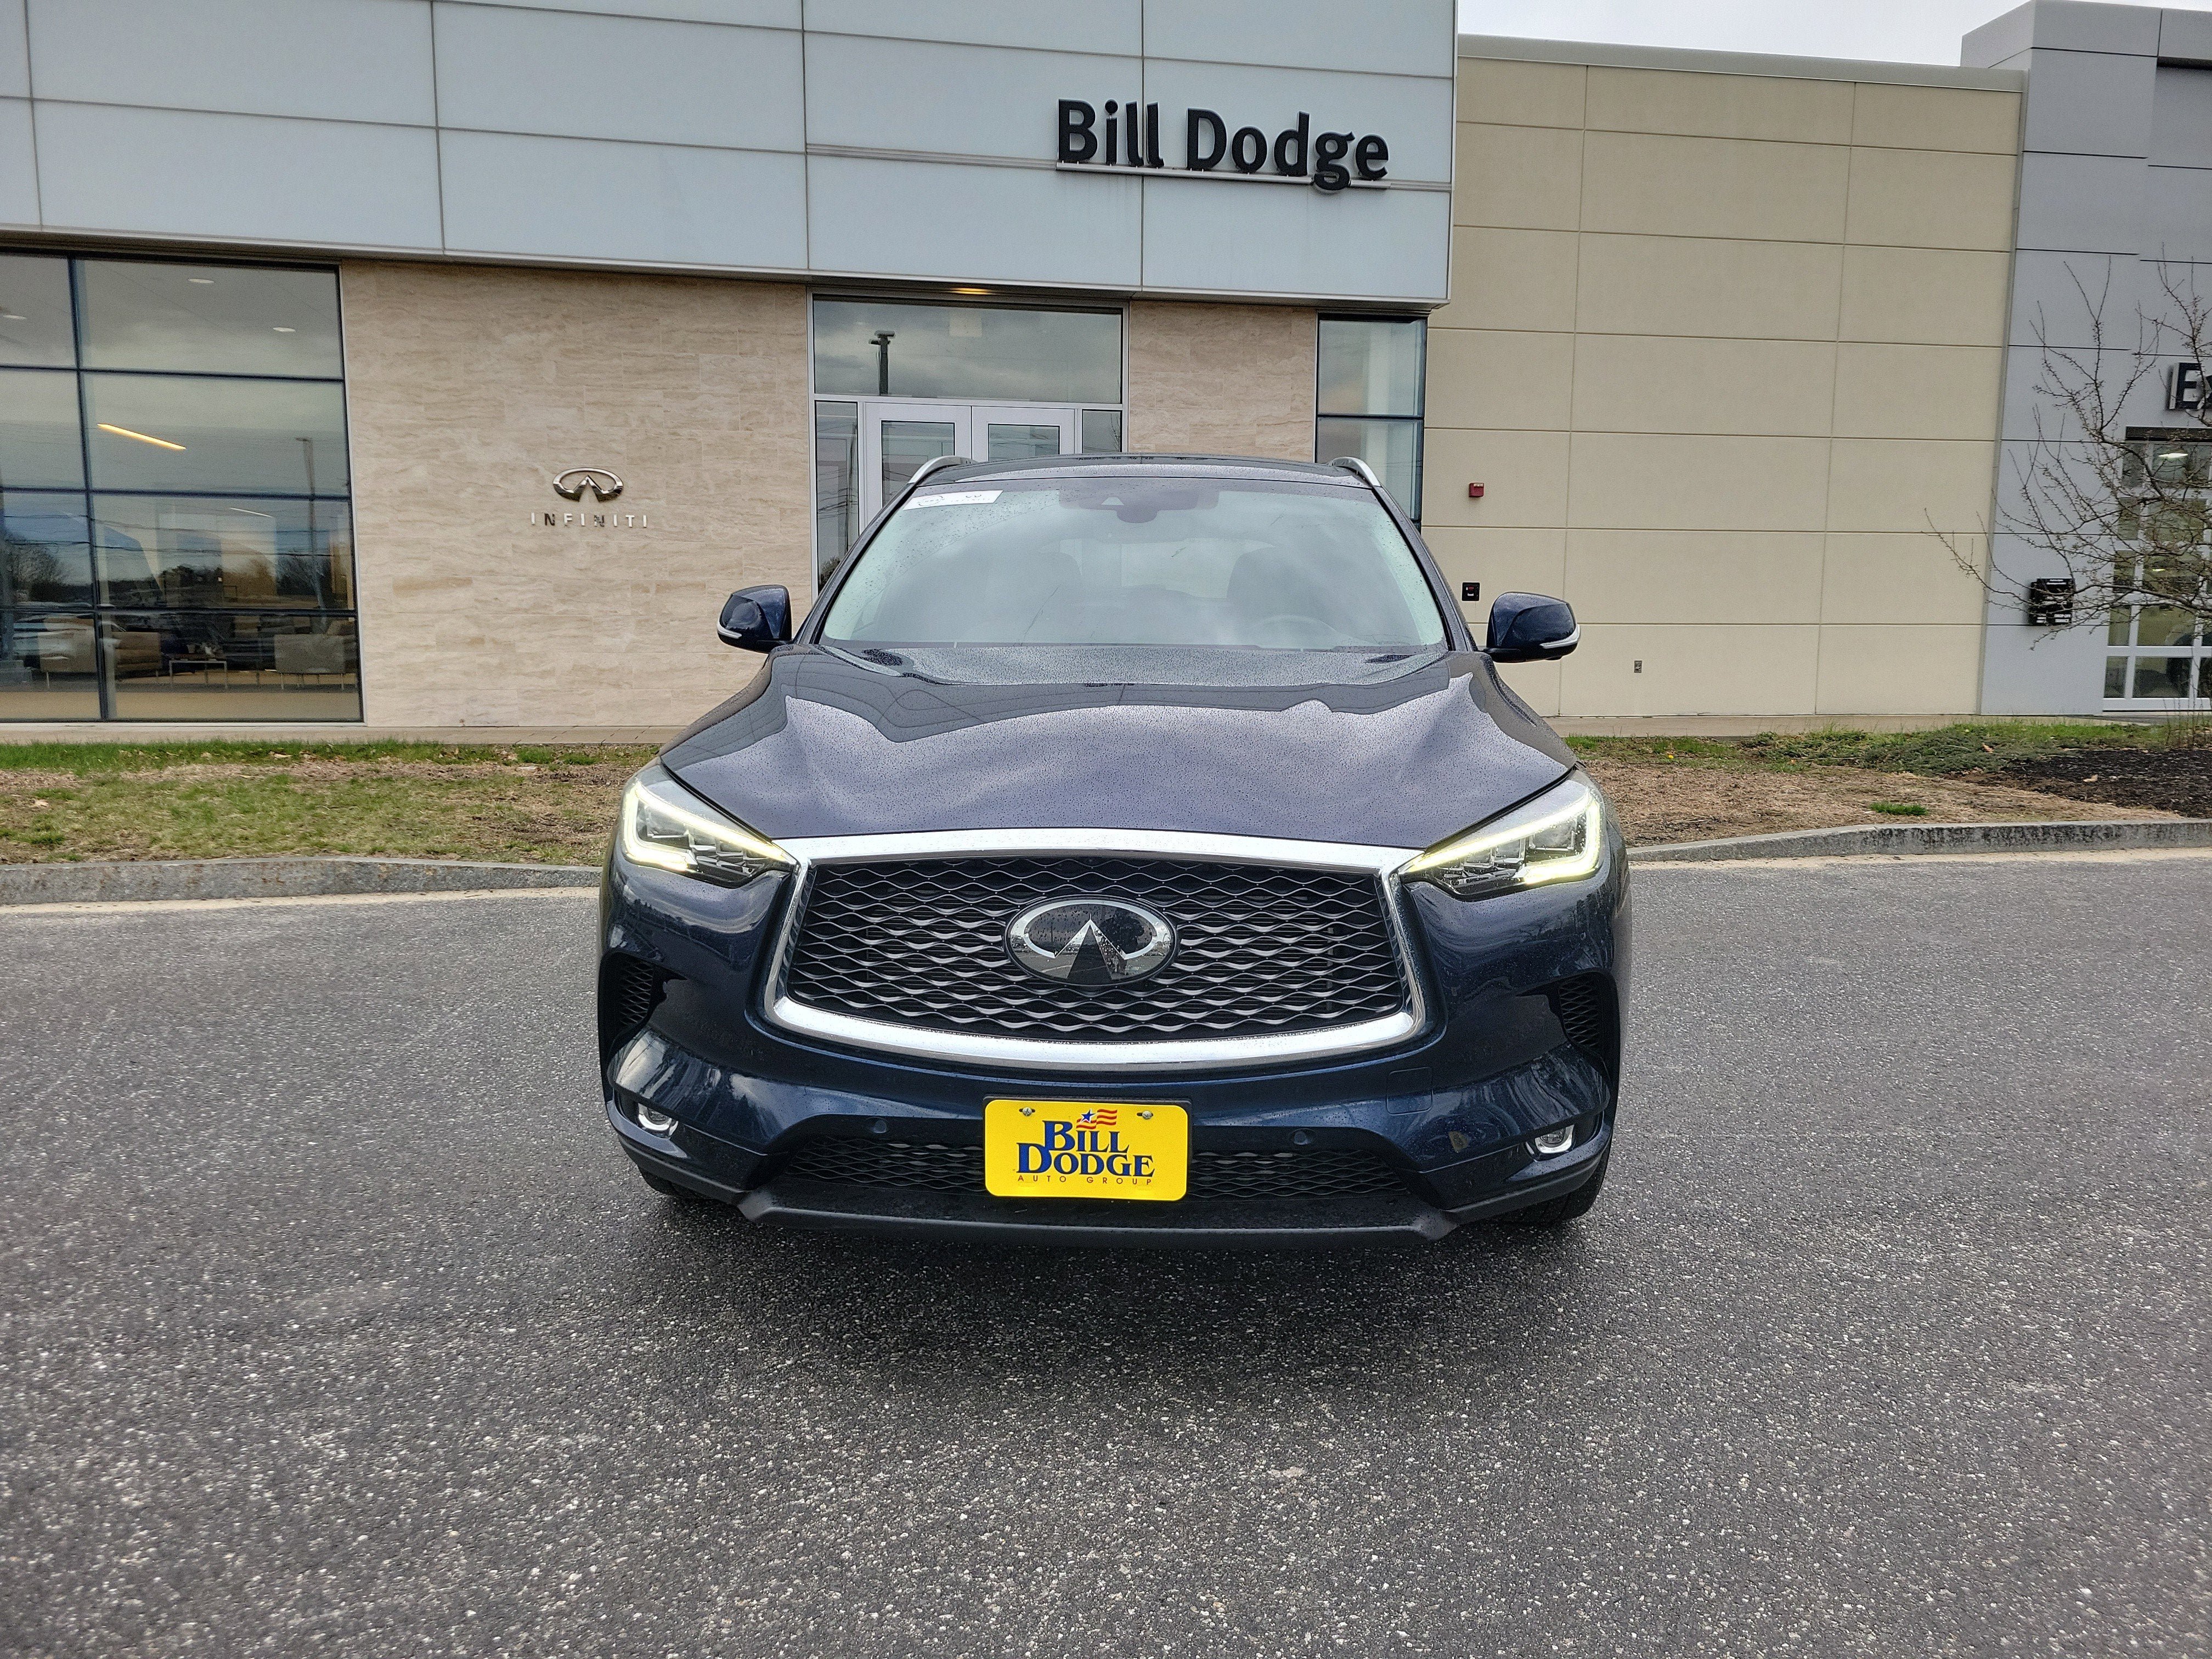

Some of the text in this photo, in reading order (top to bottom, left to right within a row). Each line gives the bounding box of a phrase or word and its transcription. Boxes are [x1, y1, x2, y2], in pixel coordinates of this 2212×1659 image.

[1058, 99, 1389, 190] Bill Dodge
[531, 512, 647, 528] INFINITI
[1042, 1120, 1130, 1153] BILL
[1016, 1142, 1155, 1177] DODGE
[1018, 1175, 1152, 1186] AUTO GROUP
